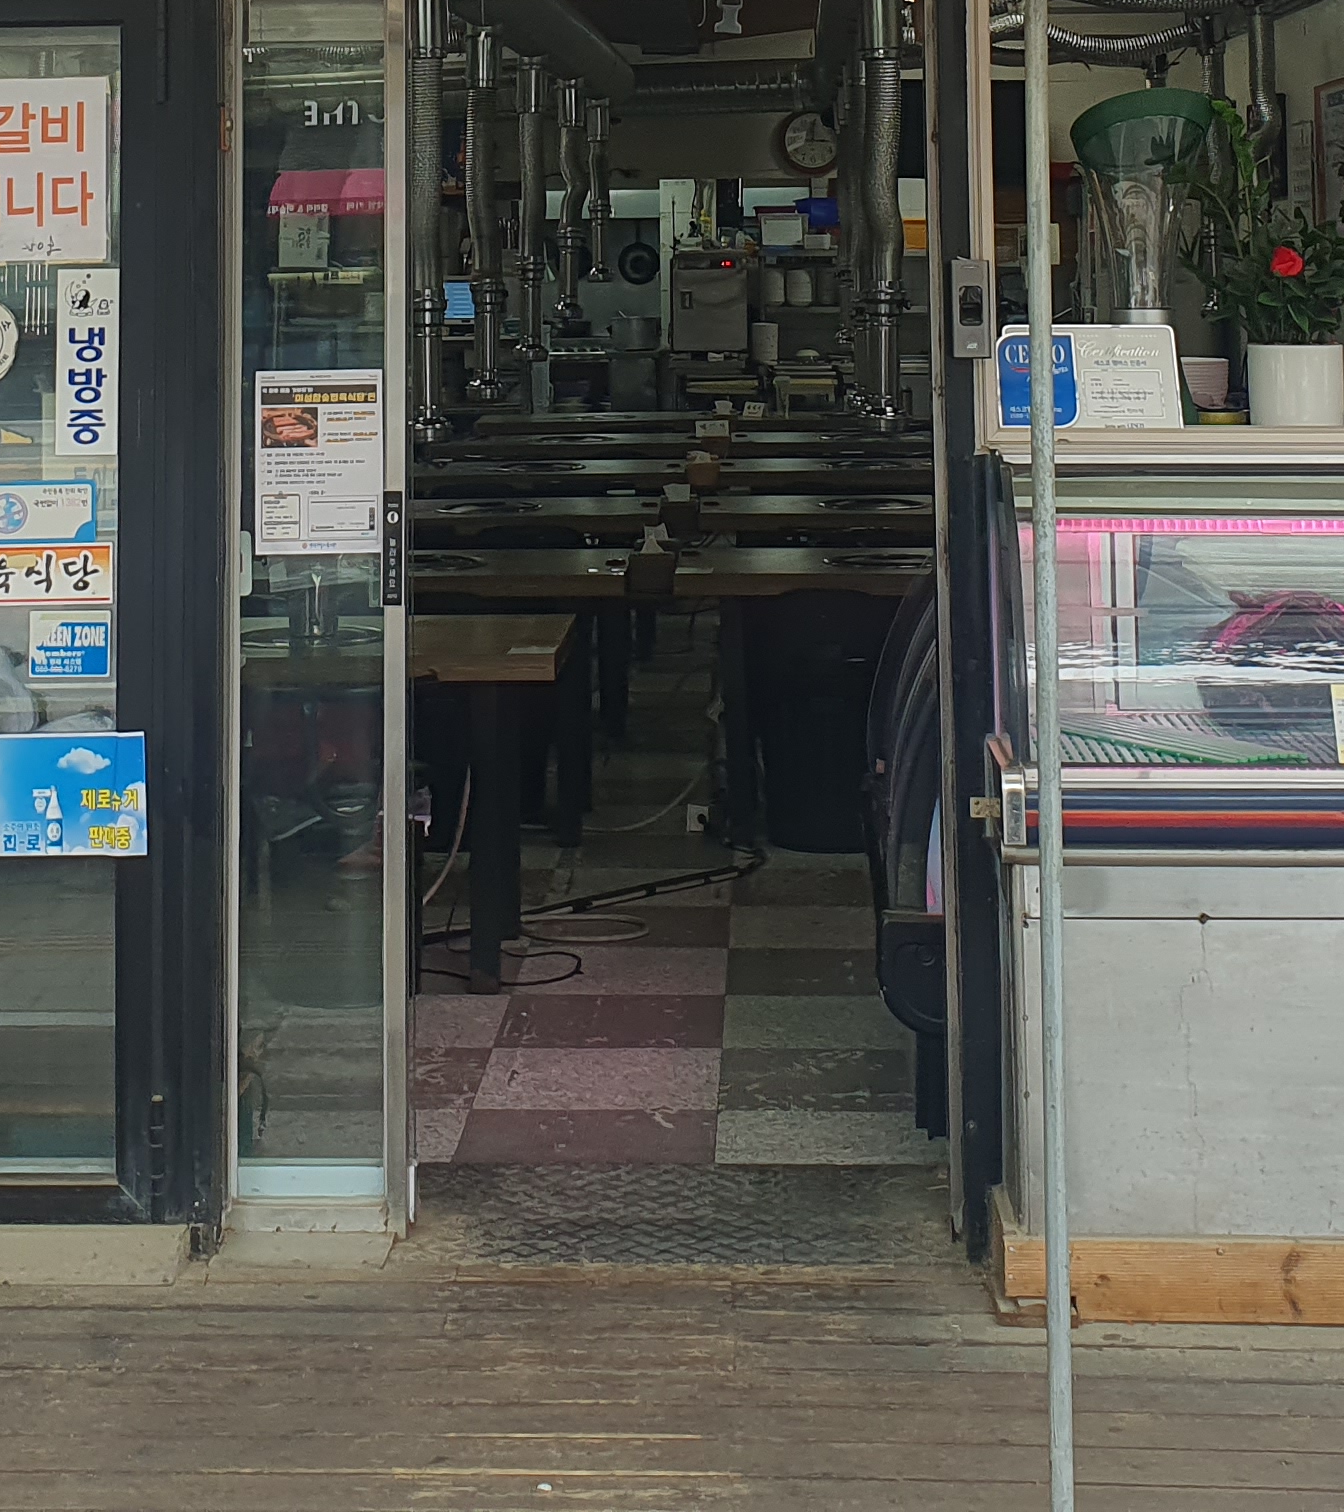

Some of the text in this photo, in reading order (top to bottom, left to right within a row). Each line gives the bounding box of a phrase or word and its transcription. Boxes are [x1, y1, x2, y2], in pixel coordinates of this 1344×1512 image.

[1076, 340, 1161, 358] Certification
[67, 327, 108, 445] 냉방중
[74, 625, 105, 647] ZONE
[80, 788, 138, 811] 제로슈거
[88, 826, 131, 849] 판매중
